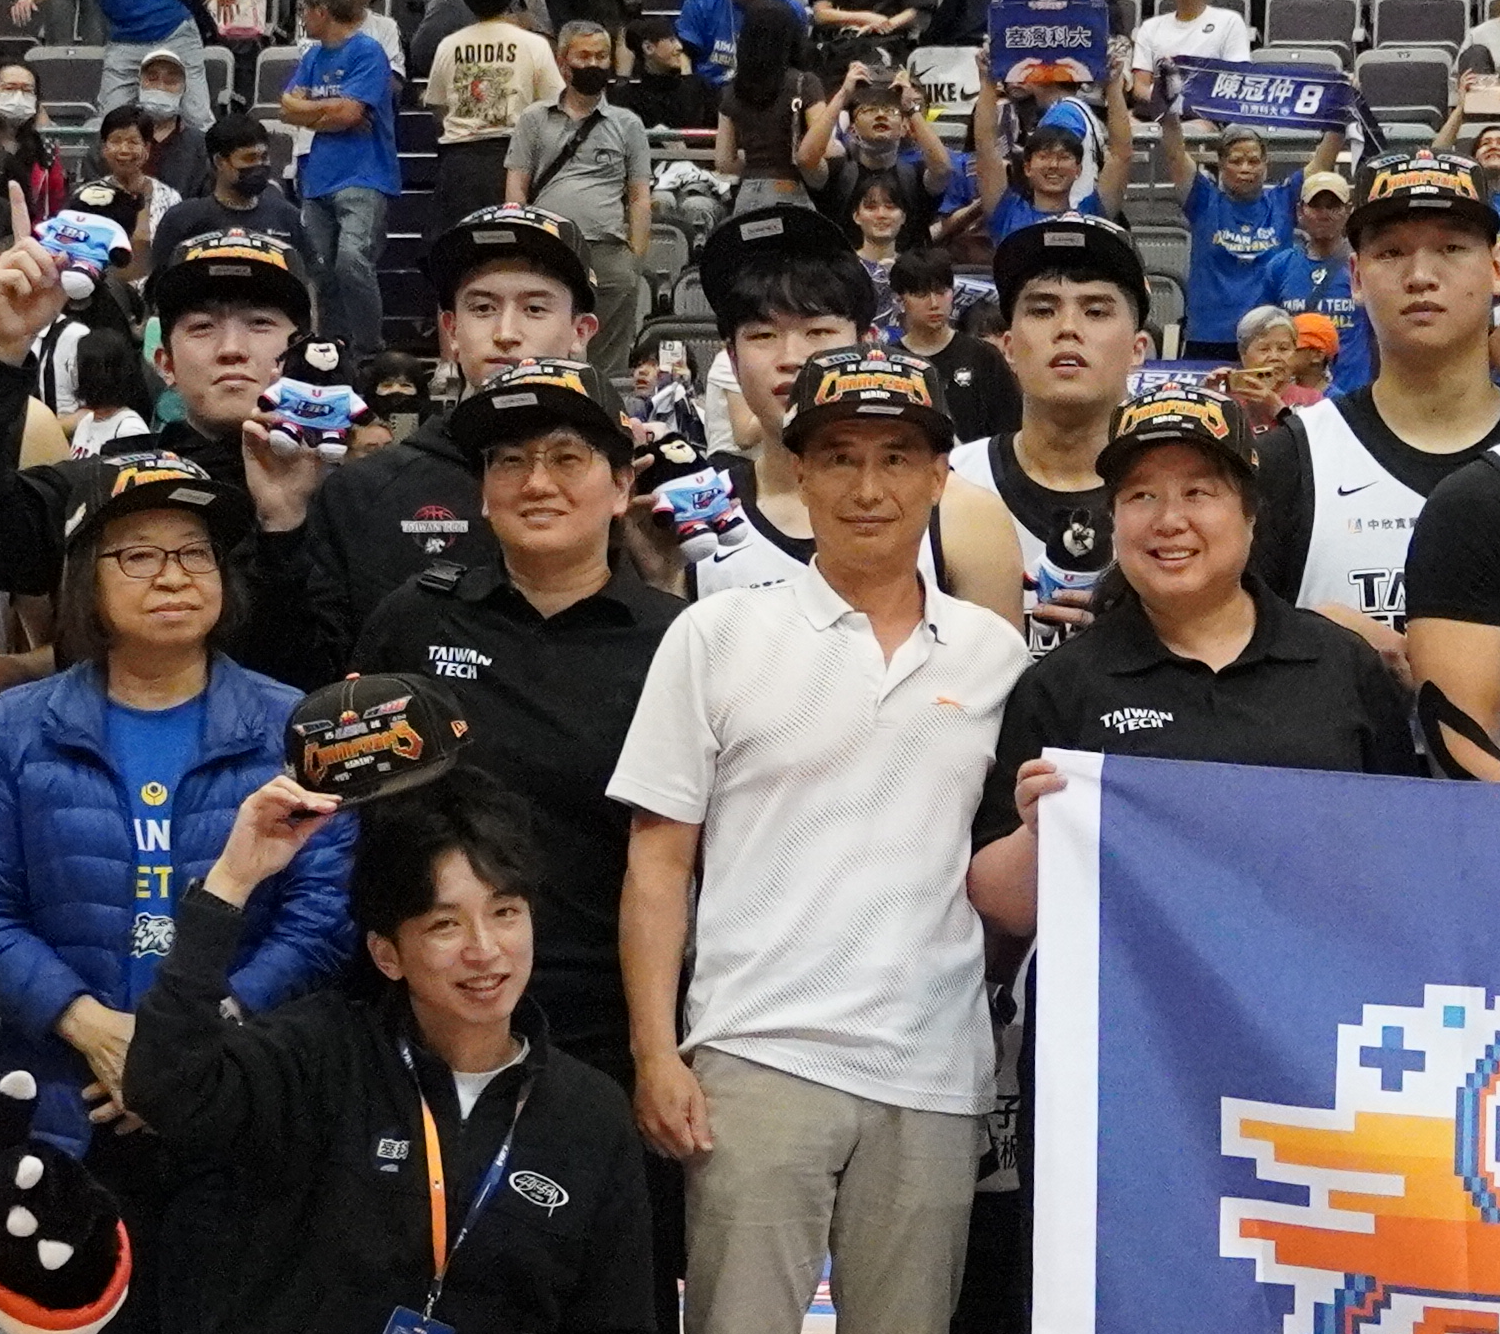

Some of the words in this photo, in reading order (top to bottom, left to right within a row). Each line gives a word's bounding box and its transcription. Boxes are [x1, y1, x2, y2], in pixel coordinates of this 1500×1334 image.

[1006, 26, 1093, 49] 臺灣科大
[454, 42, 518, 64] ADIDAS
[1211, 74, 1294, 103] 陳冠仲
[1294, 85, 1326, 115] 8
[428, 645, 493, 667] TAIWAN
[435, 661, 478, 680] TECH
[1100, 707, 1174, 728] TAIWAN
[1114, 717, 1164, 735] TECH
